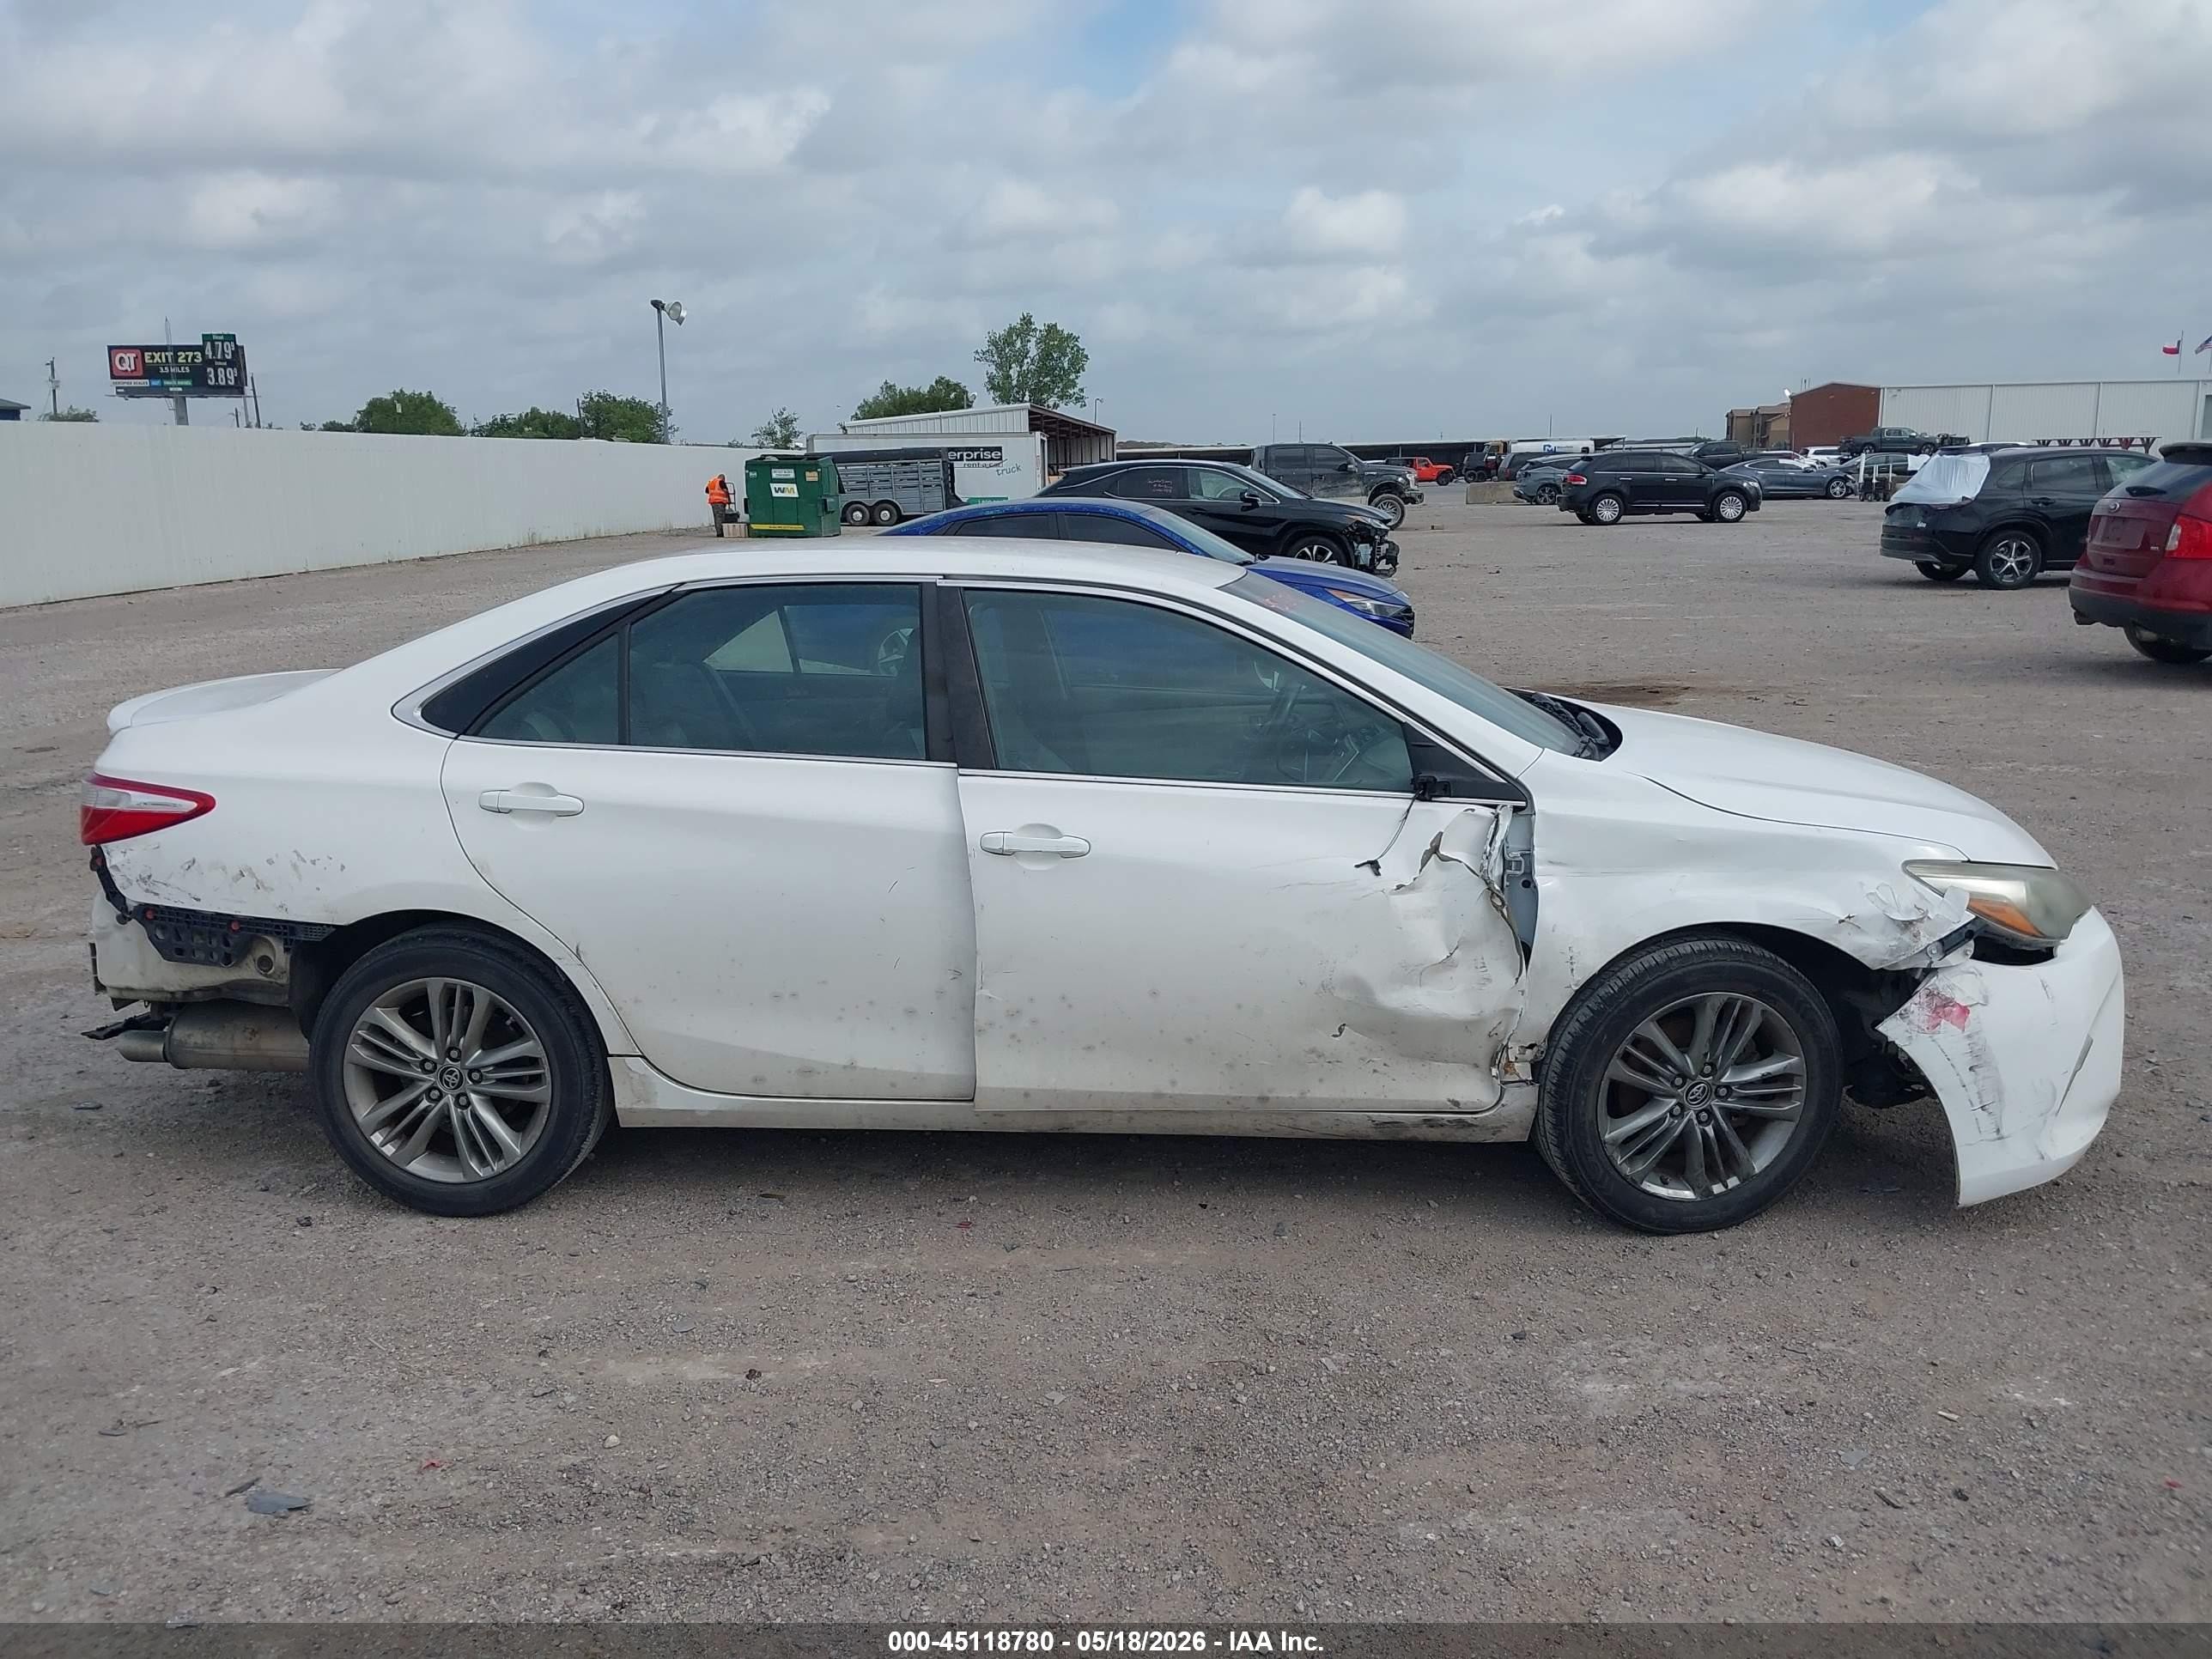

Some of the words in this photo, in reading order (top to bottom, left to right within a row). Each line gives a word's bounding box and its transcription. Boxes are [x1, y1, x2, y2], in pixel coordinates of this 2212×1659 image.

[114, 352, 137, 372] QT
[144, 351, 173, 363] EXIT
[177, 351, 203, 363] 273
[995, 463, 1022, 476] truck
[773, 485, 796, 495] WM
